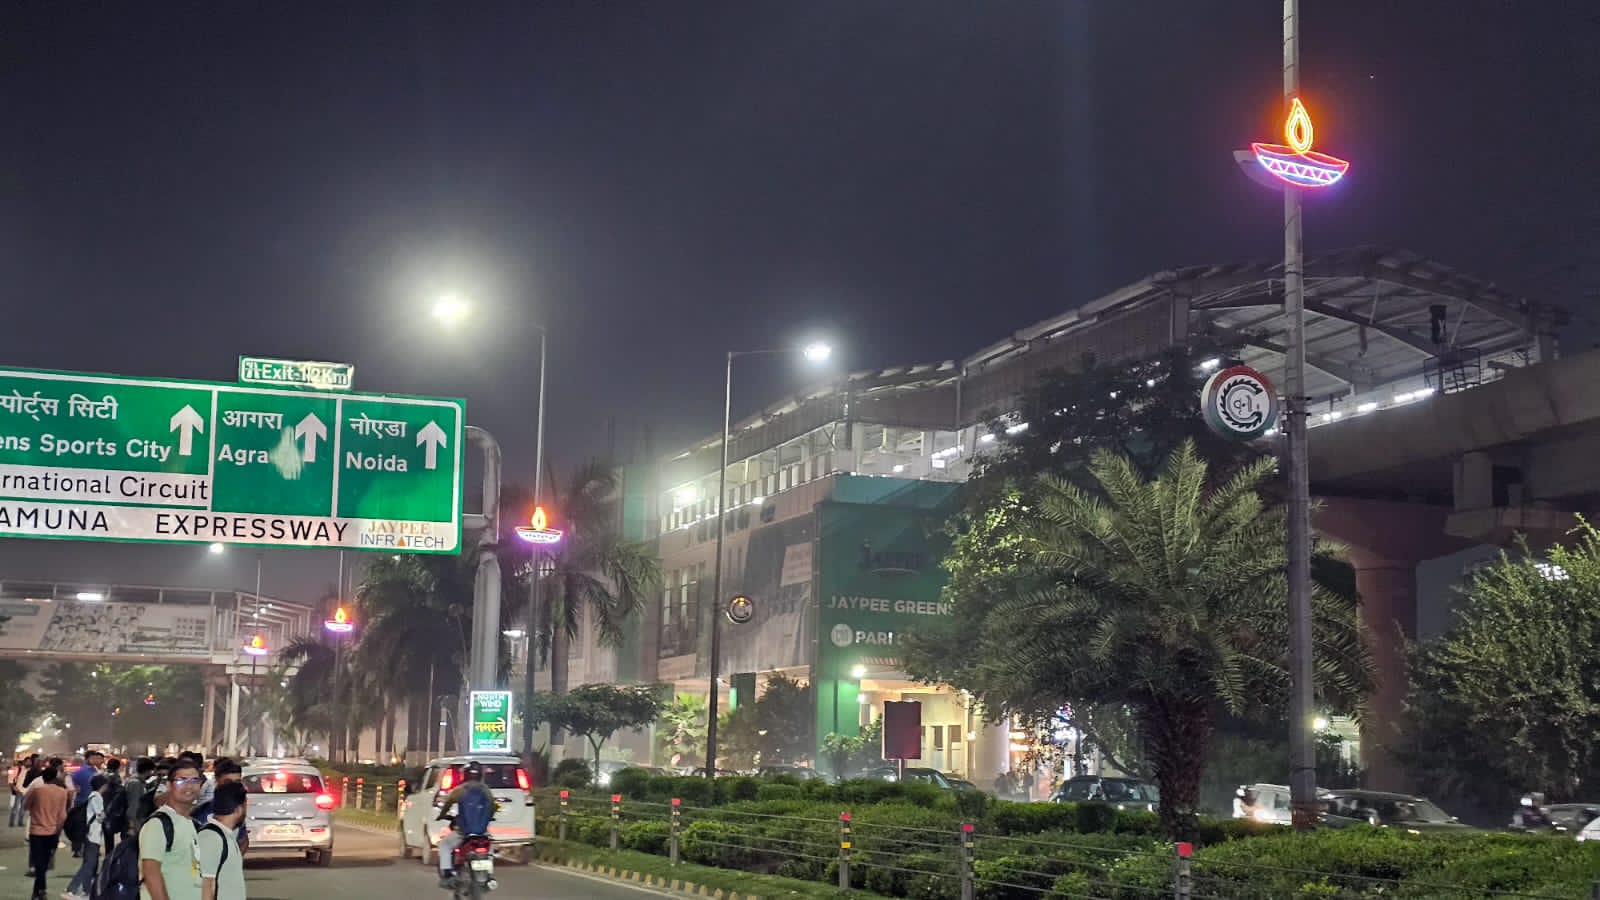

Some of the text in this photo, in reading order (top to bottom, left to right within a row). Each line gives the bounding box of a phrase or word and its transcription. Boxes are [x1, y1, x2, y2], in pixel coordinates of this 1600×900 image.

[69, 394, 118, 419] सिटी
[222, 410, 284, 430] आगरा
[349, 414, 407, 439] नोएडा
[39, 433, 116, 456] Sports
[126, 439, 171, 462] City
[218, 444, 269, 466] Agra
[346, 452, 408, 472] Noida
[119, 475, 208, 500] Circuit
[156, 513, 348, 542] EXPRESSWAY
[368, 521, 430, 536] JAYPEE
[829, 596, 890, 612] JAYPEE
[855, 631, 893, 645] PARI
